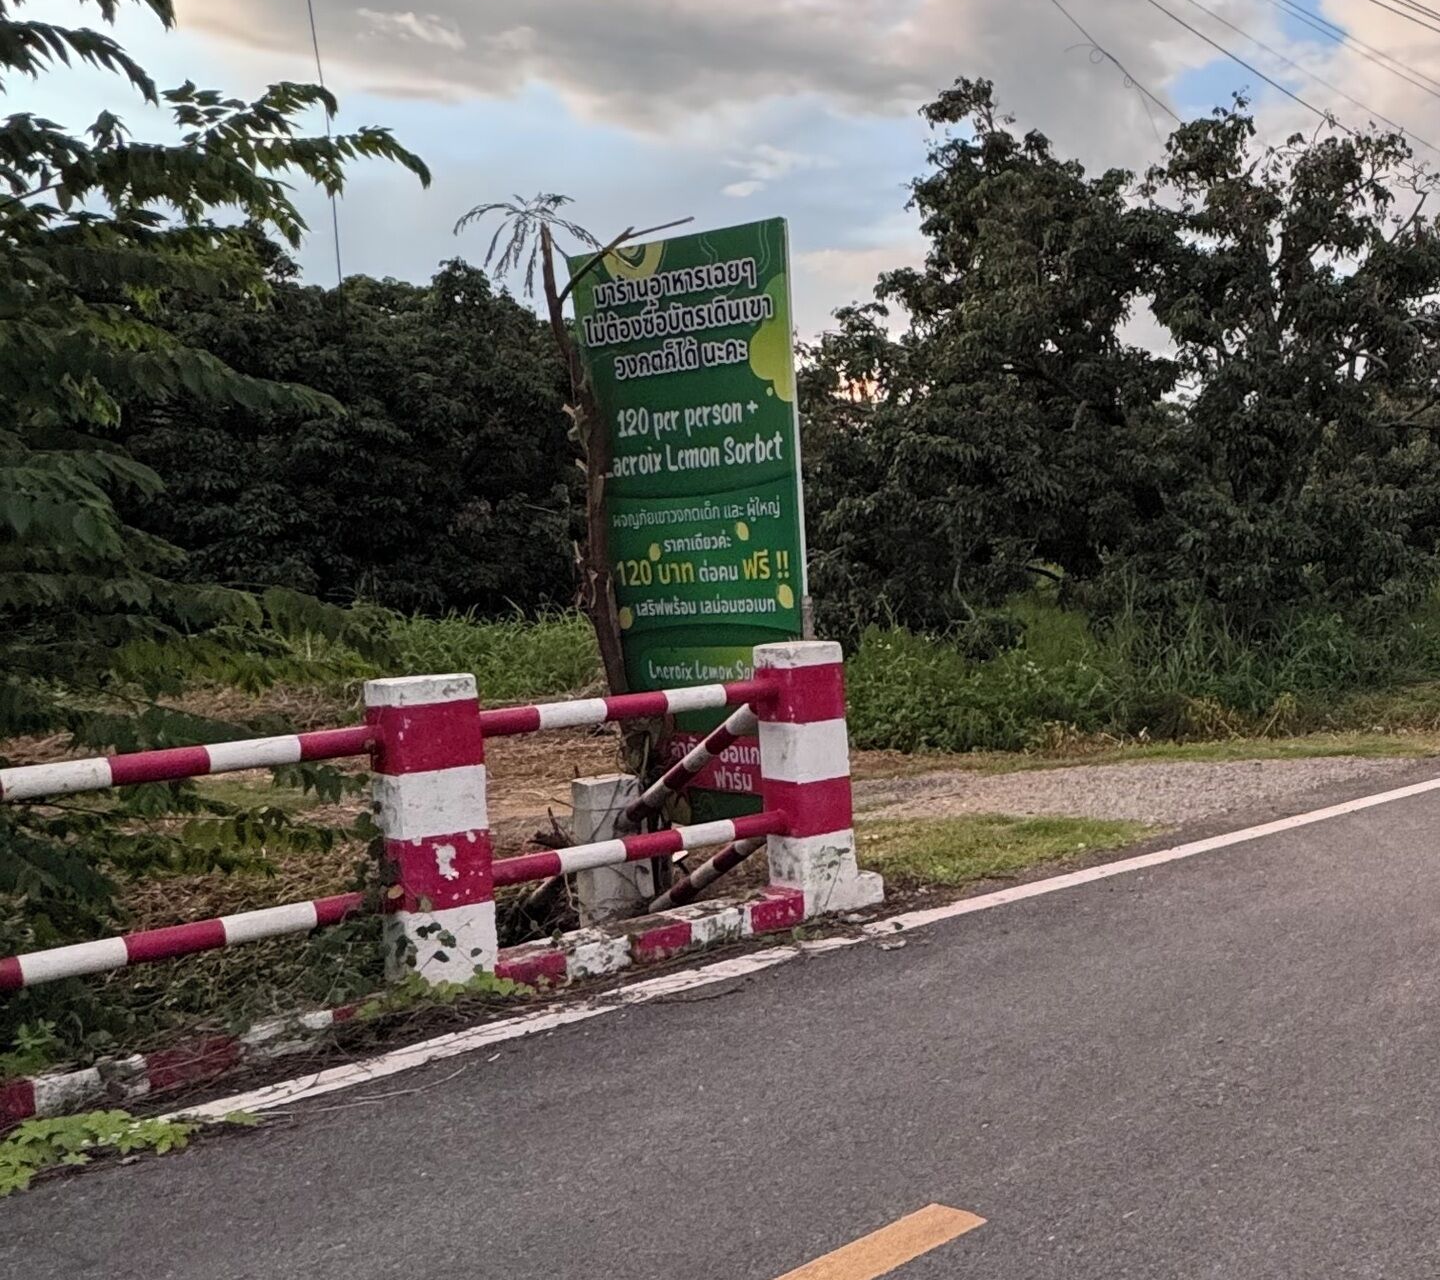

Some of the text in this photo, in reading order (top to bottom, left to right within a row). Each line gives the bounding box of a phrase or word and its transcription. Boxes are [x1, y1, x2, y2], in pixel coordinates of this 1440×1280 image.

[594, 258, 756, 306] มาร้านอาหารเฉยๆ
[584, 294, 773, 347] ไม่ต้องซื้อบัตรเดินเขา
[615, 337, 748, 380] วงกตก็ได้ นะคะ
[617, 399, 759, 440] 120 per person +
[666, 444, 720, 472] Lemon
[724, 431, 783, 465] Sorbet
[723, 504, 744, 519] และ
[747, 495, 781, 523] ผู้ใหญ่
[664, 529, 732, 553] ราคาเดียวค่ะ
[616, 549, 789, 587] 120 บาท ต่อคน ฟรี !!
[700, 593, 776, 614] เลม่อนซอเบท
[648, 659, 693, 681] Lacroix
[695, 659, 734, 681] Lemon
[713, 765, 753, 792] ฟาร์ม
